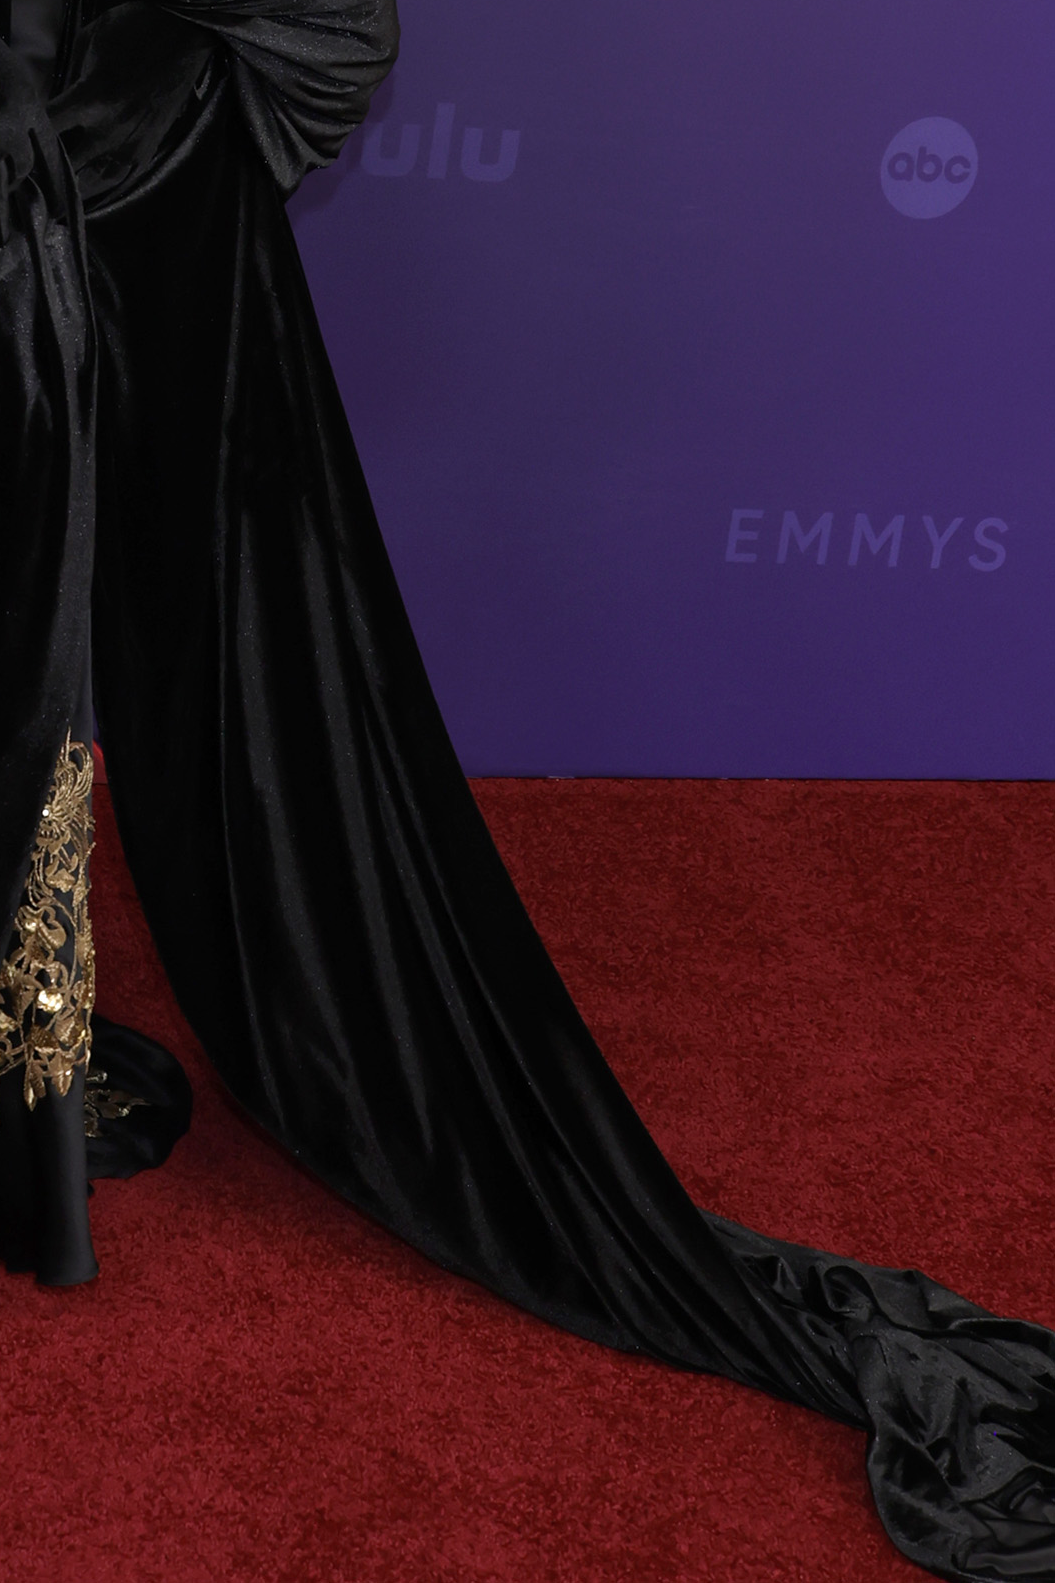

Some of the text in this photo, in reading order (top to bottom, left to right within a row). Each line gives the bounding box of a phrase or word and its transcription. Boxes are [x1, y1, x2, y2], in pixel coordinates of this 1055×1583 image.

[327, 102, 521, 182] ulu
[887, 146, 971, 184] abc
[725, 508, 1009, 572] EMMYS
